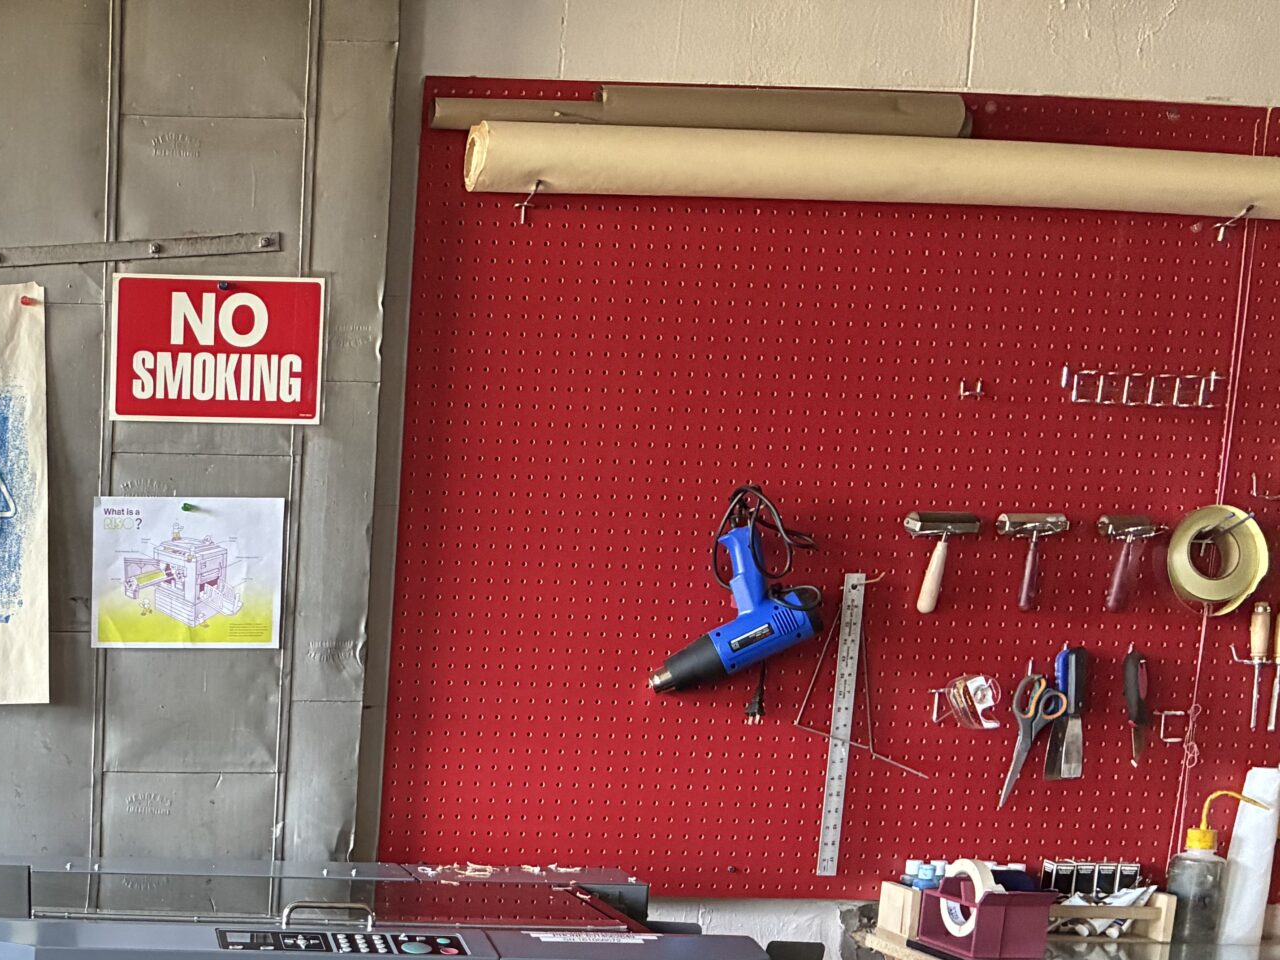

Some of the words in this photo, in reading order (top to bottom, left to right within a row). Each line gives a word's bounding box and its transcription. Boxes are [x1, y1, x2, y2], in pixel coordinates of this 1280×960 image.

[170, 291, 269, 348] NO
[132, 350, 303, 403] SMOKING
[104, 508, 125, 516] What
[126, 508, 134, 516] is
